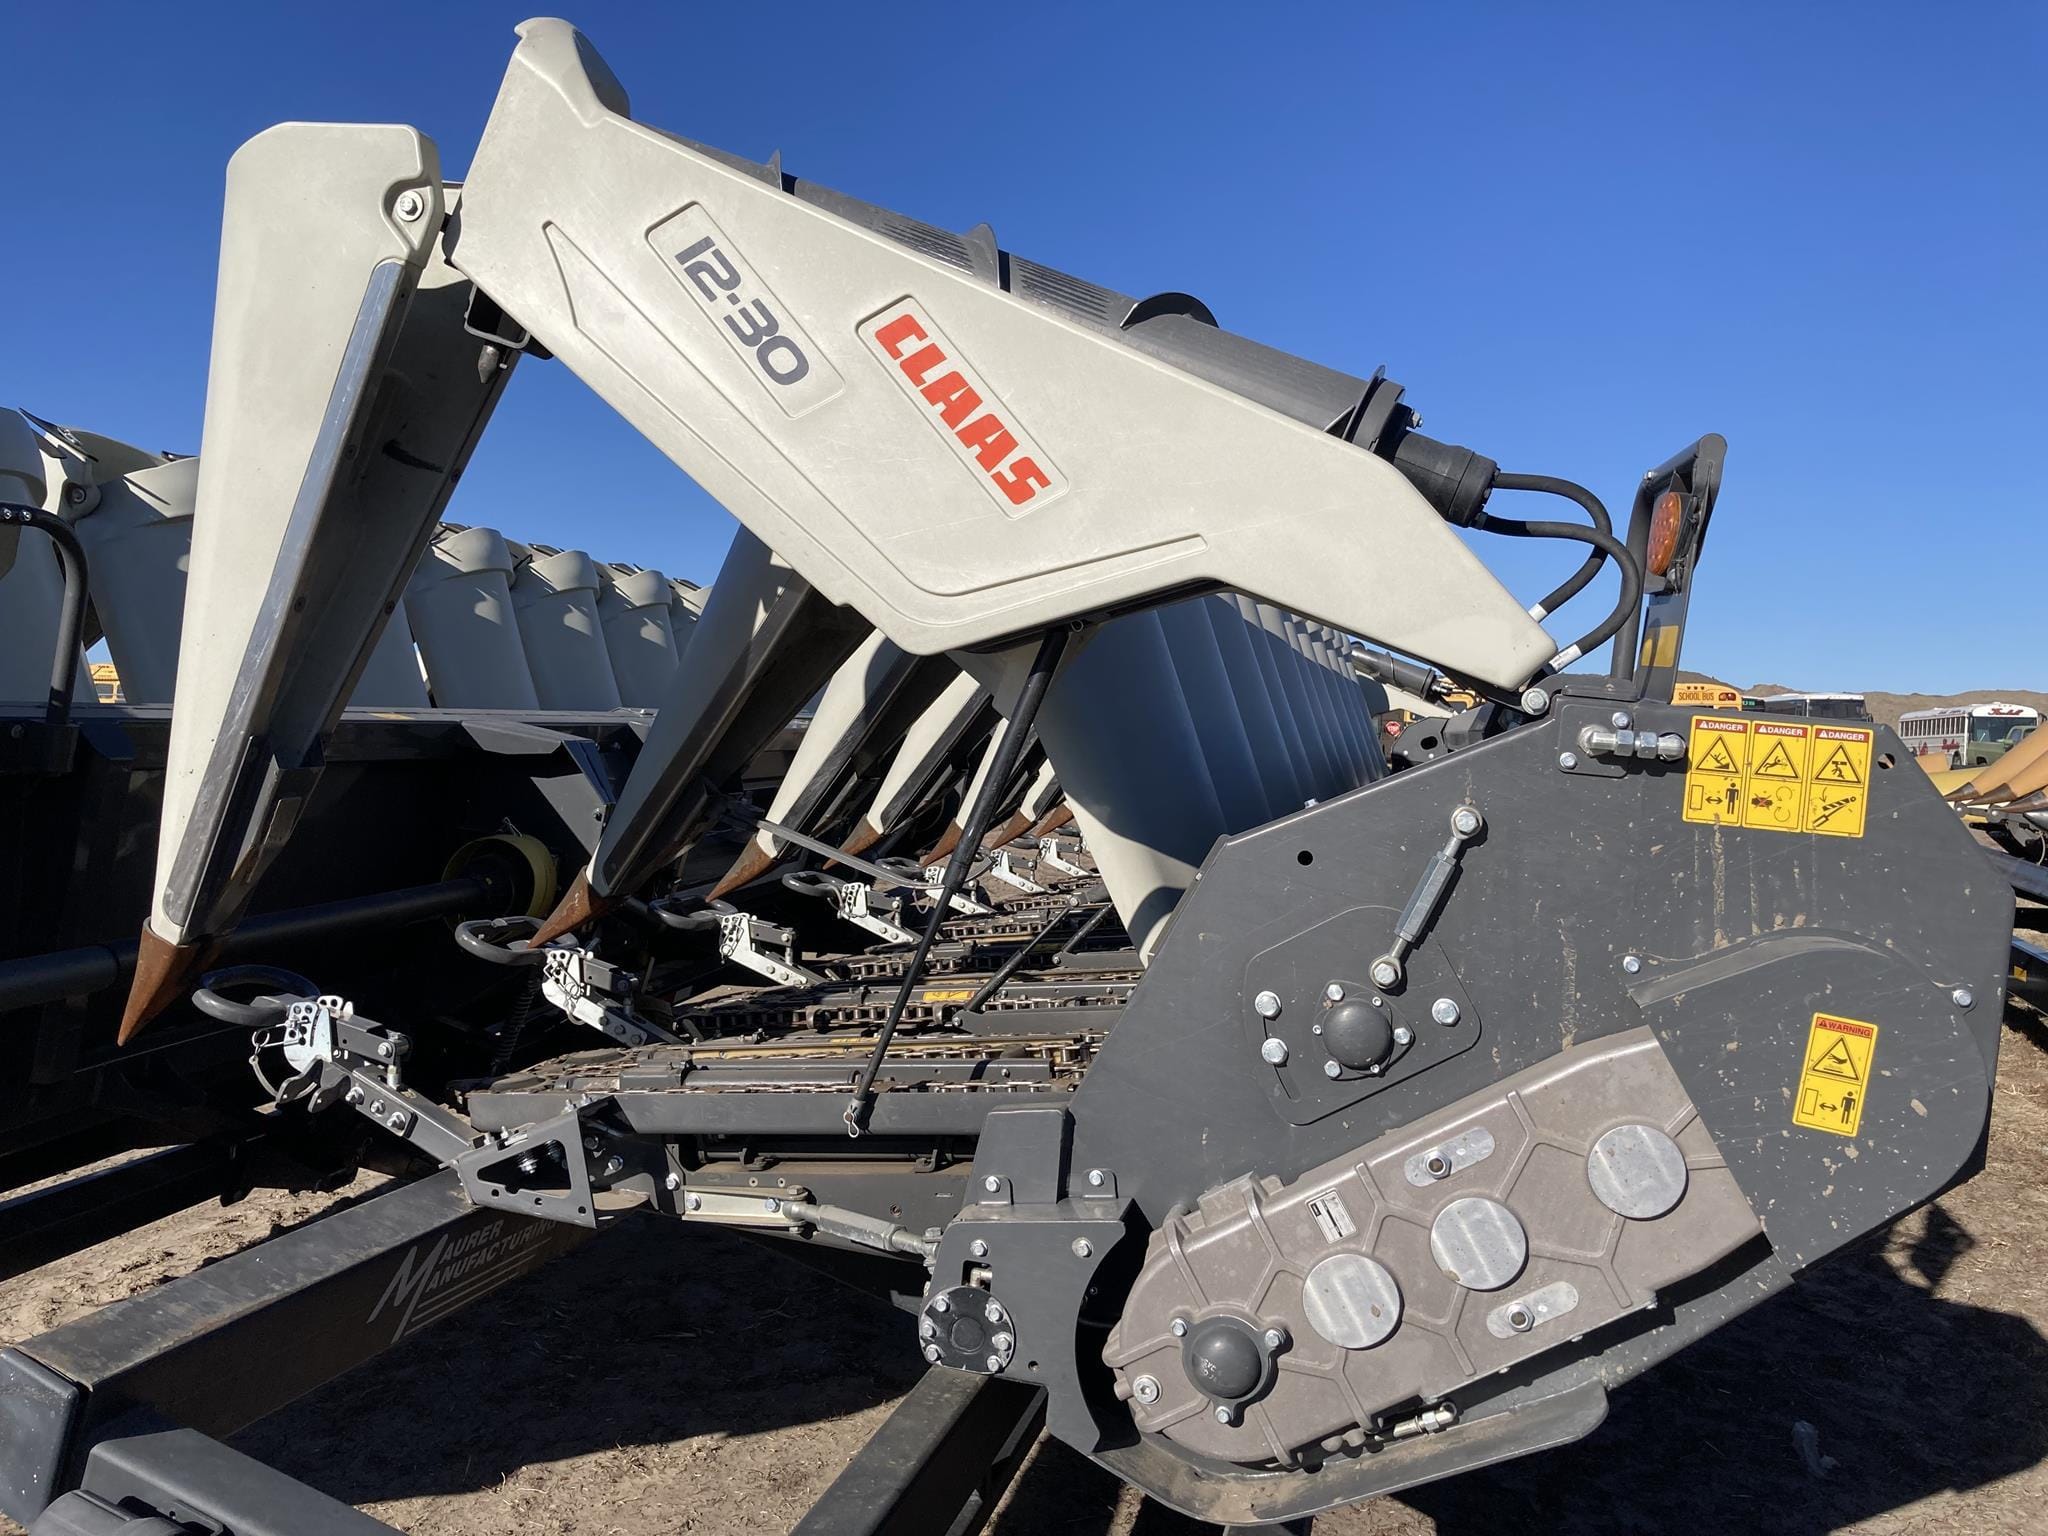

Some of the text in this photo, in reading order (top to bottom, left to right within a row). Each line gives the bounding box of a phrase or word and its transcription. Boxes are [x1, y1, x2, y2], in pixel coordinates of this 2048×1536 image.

[875, 313, 1052, 506] CLAAS
[1678, 692, 1715, 701] SCHOOL BUS
[1708, 723, 1744, 732] DANGER
[1767, 727, 1803, 736] DANGER
[1828, 731, 1865, 741] DANGER
[1828, 1024, 1872, 1037] WARNING
